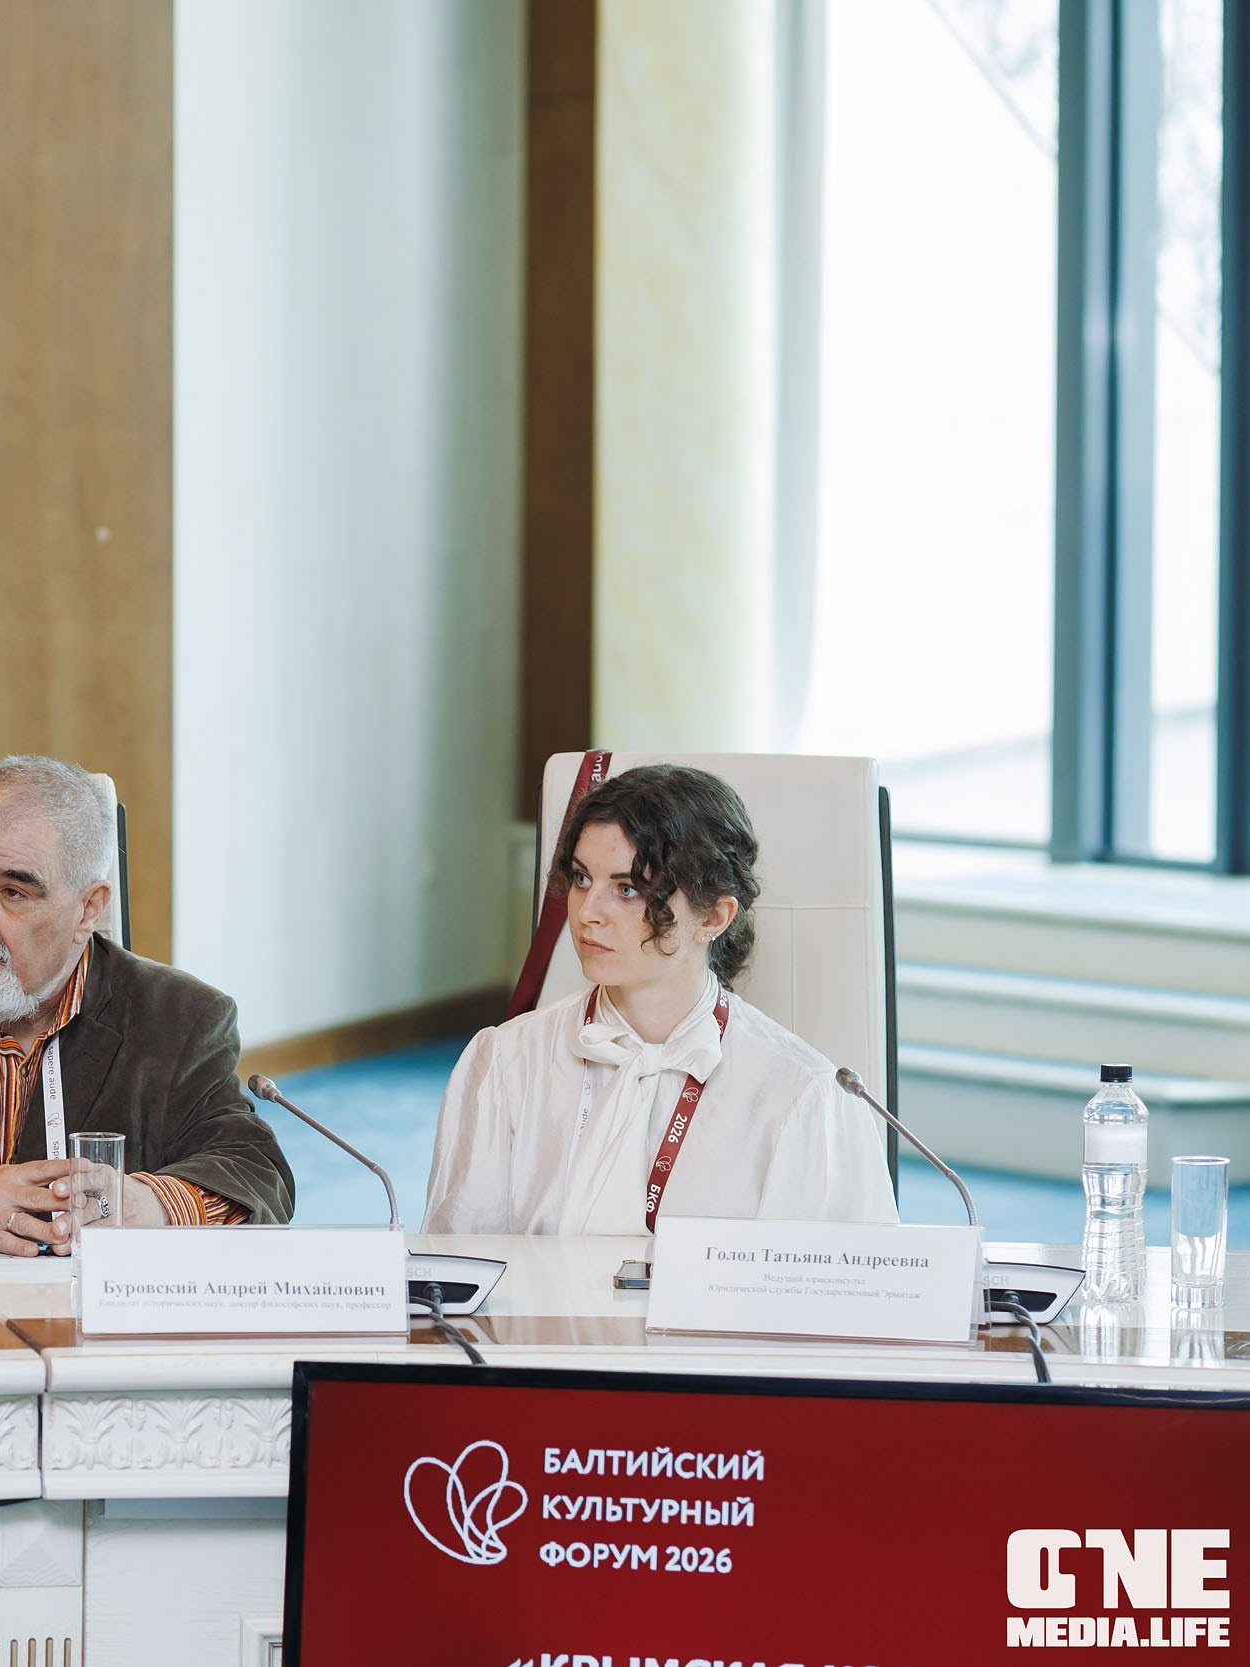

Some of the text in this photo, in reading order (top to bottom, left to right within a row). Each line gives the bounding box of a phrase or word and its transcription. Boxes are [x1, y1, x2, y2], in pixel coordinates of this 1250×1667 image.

[49, 1077, 58, 1100] aude
[668, 1112, 688, 1144] 2026
[646, 1183, 661, 1213] БКФ
[705, 1247, 929, 1270] Голод Татьяна Андреевна
[406, 1267, 433, 1279] SCH
[982, 1275, 1009, 1286] SCH
[103, 1280, 385, 1298] Буровский Андрей Михайлович
[544, 1447, 765, 1481] БАЛТИЙСКИЙ
[542, 1494, 755, 1527] КУЛЬТУРНЫЙ
[540, 1542, 733, 1574] ФОРУМ 2026
